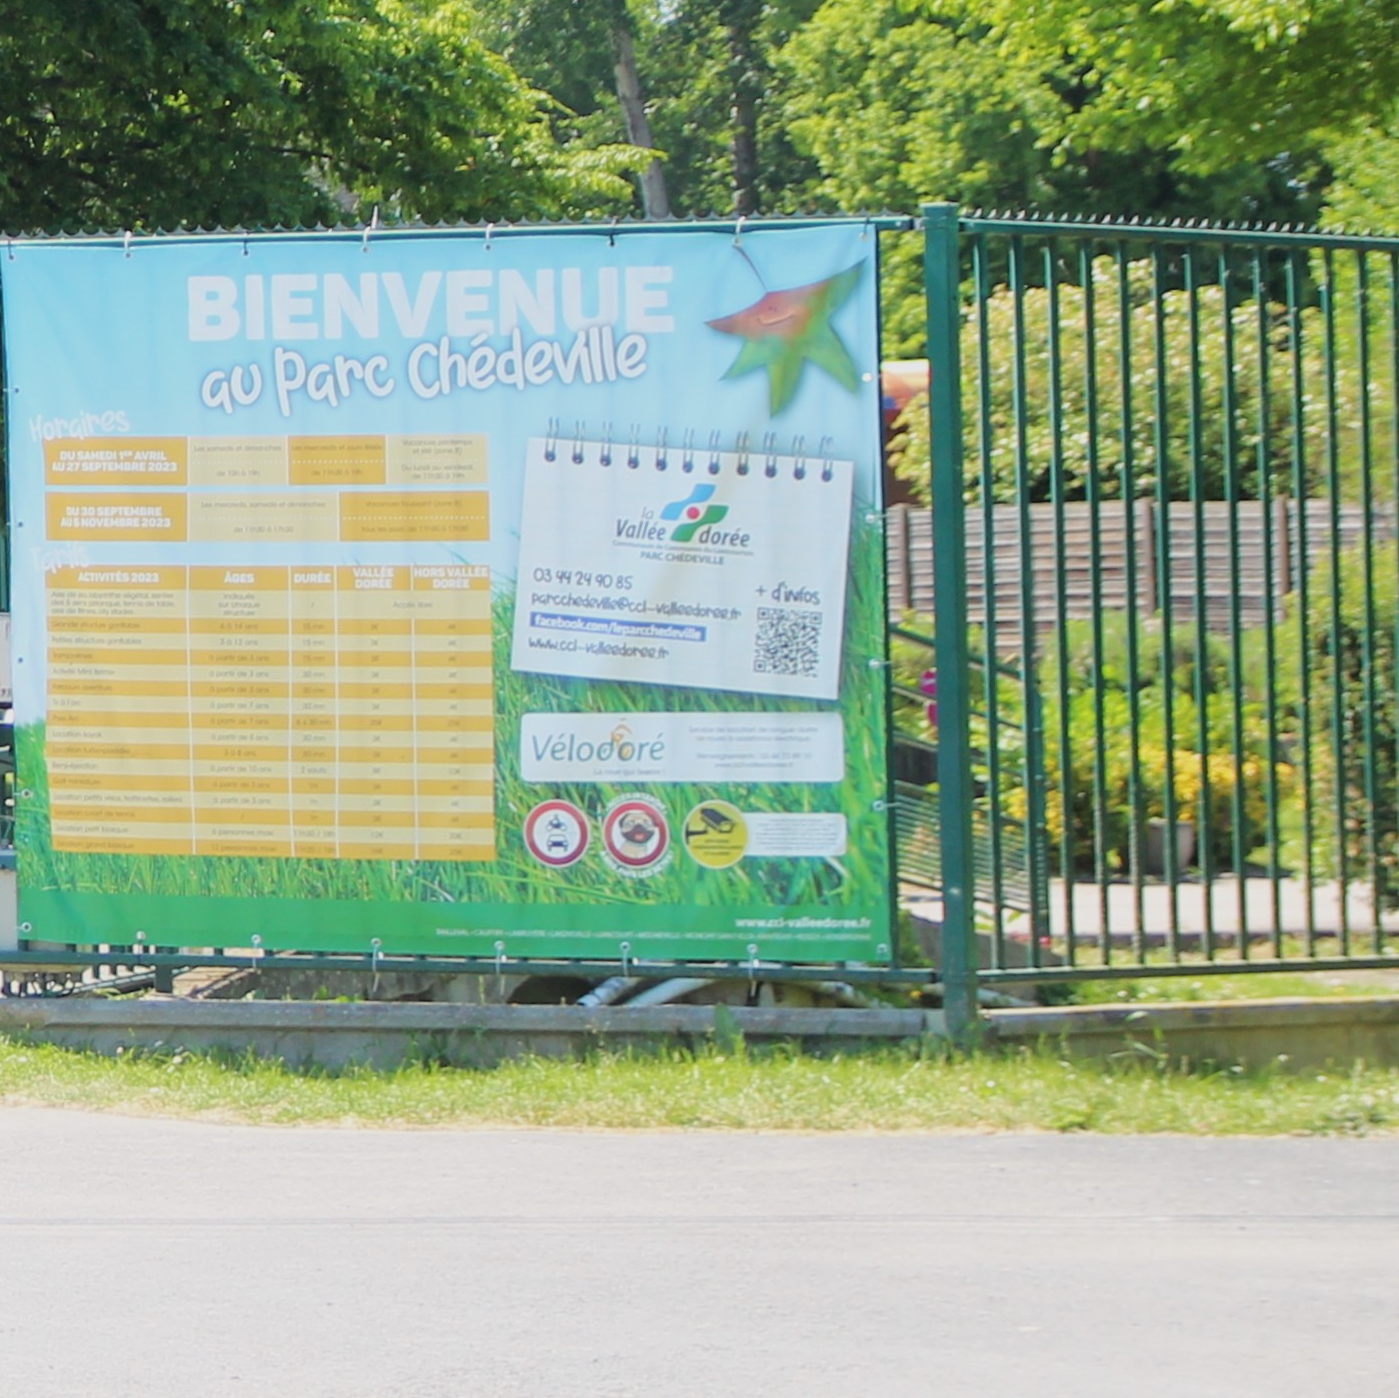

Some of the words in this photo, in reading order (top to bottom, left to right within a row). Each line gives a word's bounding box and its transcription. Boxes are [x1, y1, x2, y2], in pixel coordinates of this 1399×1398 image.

[187, 266, 674, 341] BIENVENUE
[201, 362, 261, 414] au
[275, 347, 395, 418] Parc
[408, 327, 647, 400] Chédeville
[29, 409, 131, 442] Horaires
[60, 451, 76, 460] DU
[77, 451, 117, 460] SAMEDI
[134, 451, 167, 460] AVRIL
[52, 462, 66, 472] AU
[67, 462, 80, 472] 27
[81, 462, 146, 472] SEPTEMBRE
[147, 462, 178, 472] 2023
[66, 507, 80, 516] DU
[81, 507, 95, 516] 30
[96, 507, 162, 516] SEPTEMBRE
[641, 506, 654, 520] la
[60, 518, 73, 527] AU
[73, 518, 80, 527] 5
[81, 518, 140, 527] NOVEMBRE
[141, 518, 171, 527] 2023
[615, 518, 667, 541] Vallée
[698, 526, 751, 547] dorée
[30, 540, 91, 574] Tarifs
[640, 550, 663, 561] PARC
[665, 551, 725, 566] CHÉDEVILLE
[78, 572, 130, 583] ACTIVITÉS
[131, 573, 159, 583] 2023
[224, 570, 255, 584] ÂGES
[294, 572, 332, 584] DURÉE
[352, 565, 395, 578] VALLÉE
[414, 567, 445, 578] HORS
[447, 565, 488, 577] VALLÉE
[355, 578, 393, 589] DORÉE
[432, 578, 471, 589] DORÉE
[533, 568, 552, 583] 03
[555, 569, 572, 585] 44
[574, 571, 592, 587] 24
[595, 574, 613, 588] 90
[616, 575, 634, 590] 85
[771, 580, 821, 606] d'infos
[531, 731, 666, 762] Vélodoré
